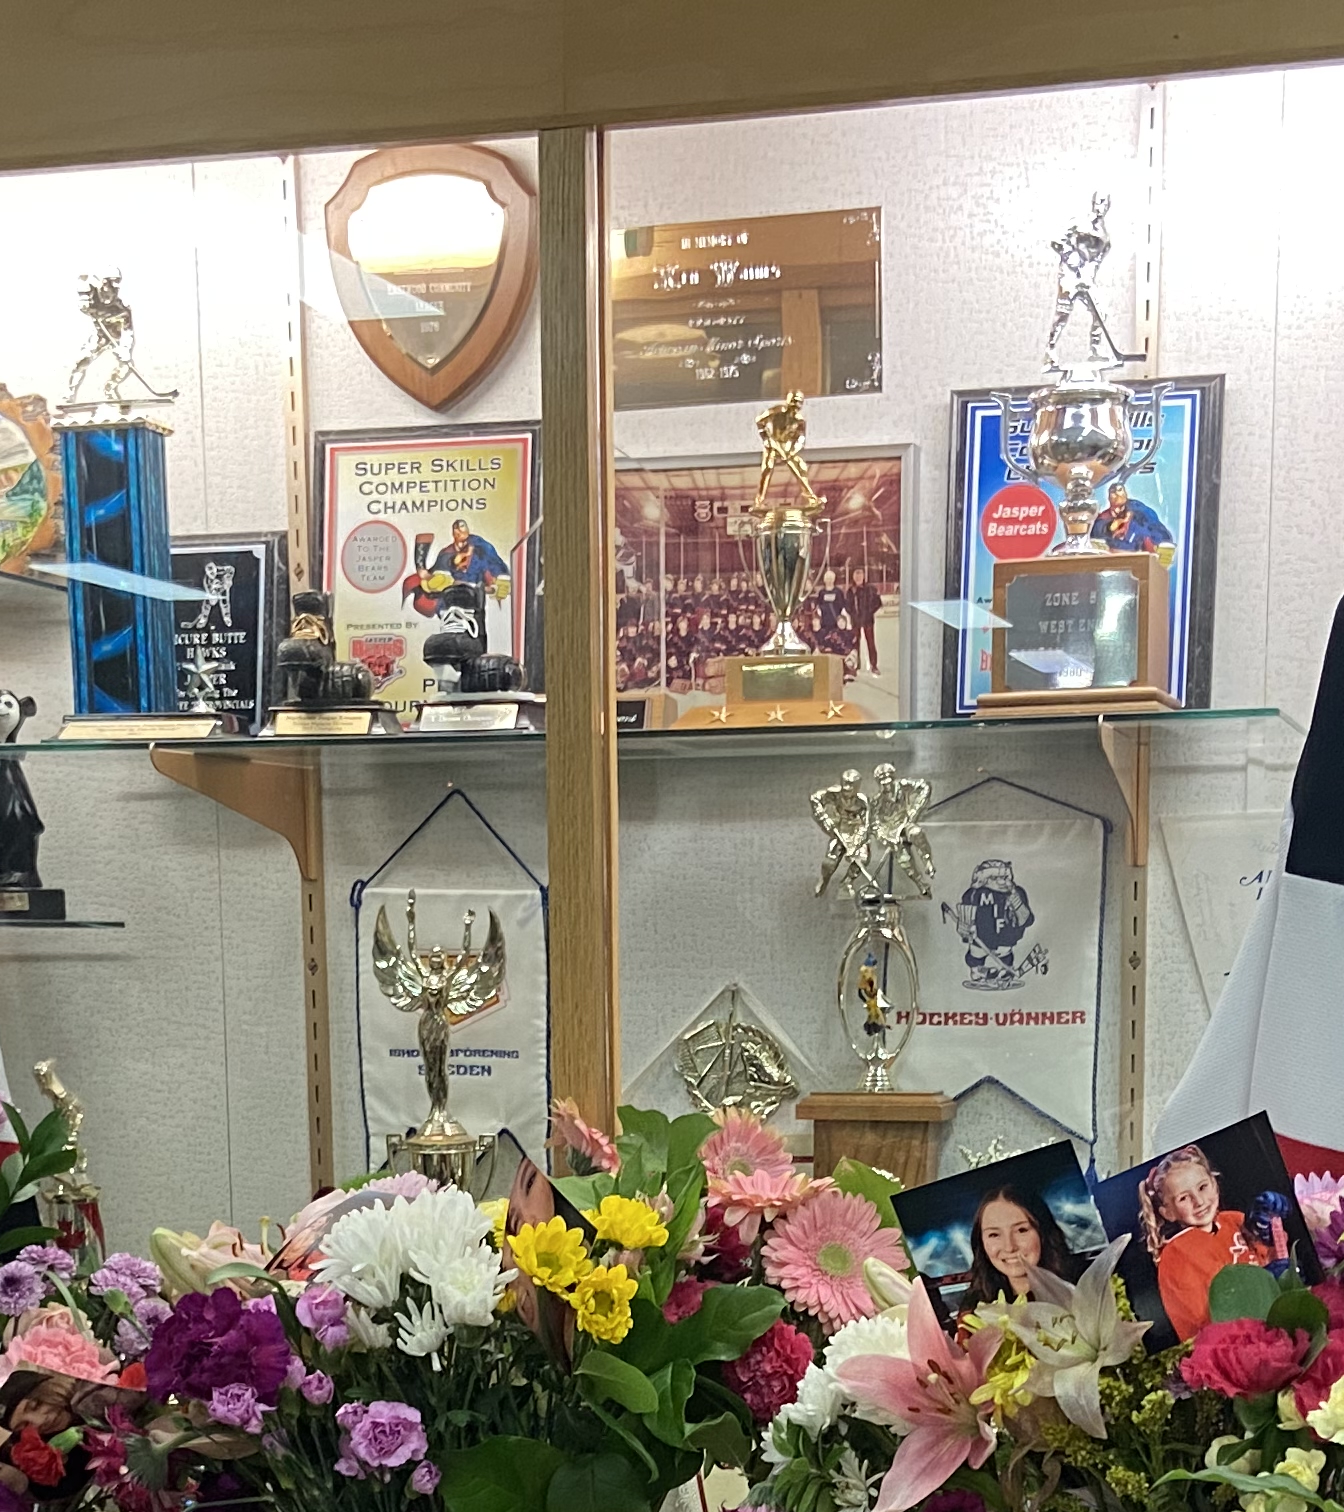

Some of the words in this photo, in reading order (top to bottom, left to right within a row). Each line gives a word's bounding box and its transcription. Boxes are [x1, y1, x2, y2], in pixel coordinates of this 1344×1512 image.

[355, 461, 422, 477] SUPER
[431, 457, 502, 473] SKILLS
[359, 477, 496, 496] COMPETITION
[367, 497, 487, 515] CHAMPIONS
[992, 503, 1046, 521] Jasper
[987, 520, 1049, 538] Bearcats
[355, 555, 391, 563] JASPER
[361, 573, 386, 582] TEAM
[1044, 592, 1080, 607] ZONE
[346, 622, 403, 631] PRESENTED
[405, 621, 419, 630] BY
[1038, 619, 1075, 634] WEST
[212, 631, 247, 644] BUTTE
[186, 646, 227, 659] HWKS
[418, 1064, 492, 1077] SEDEN
